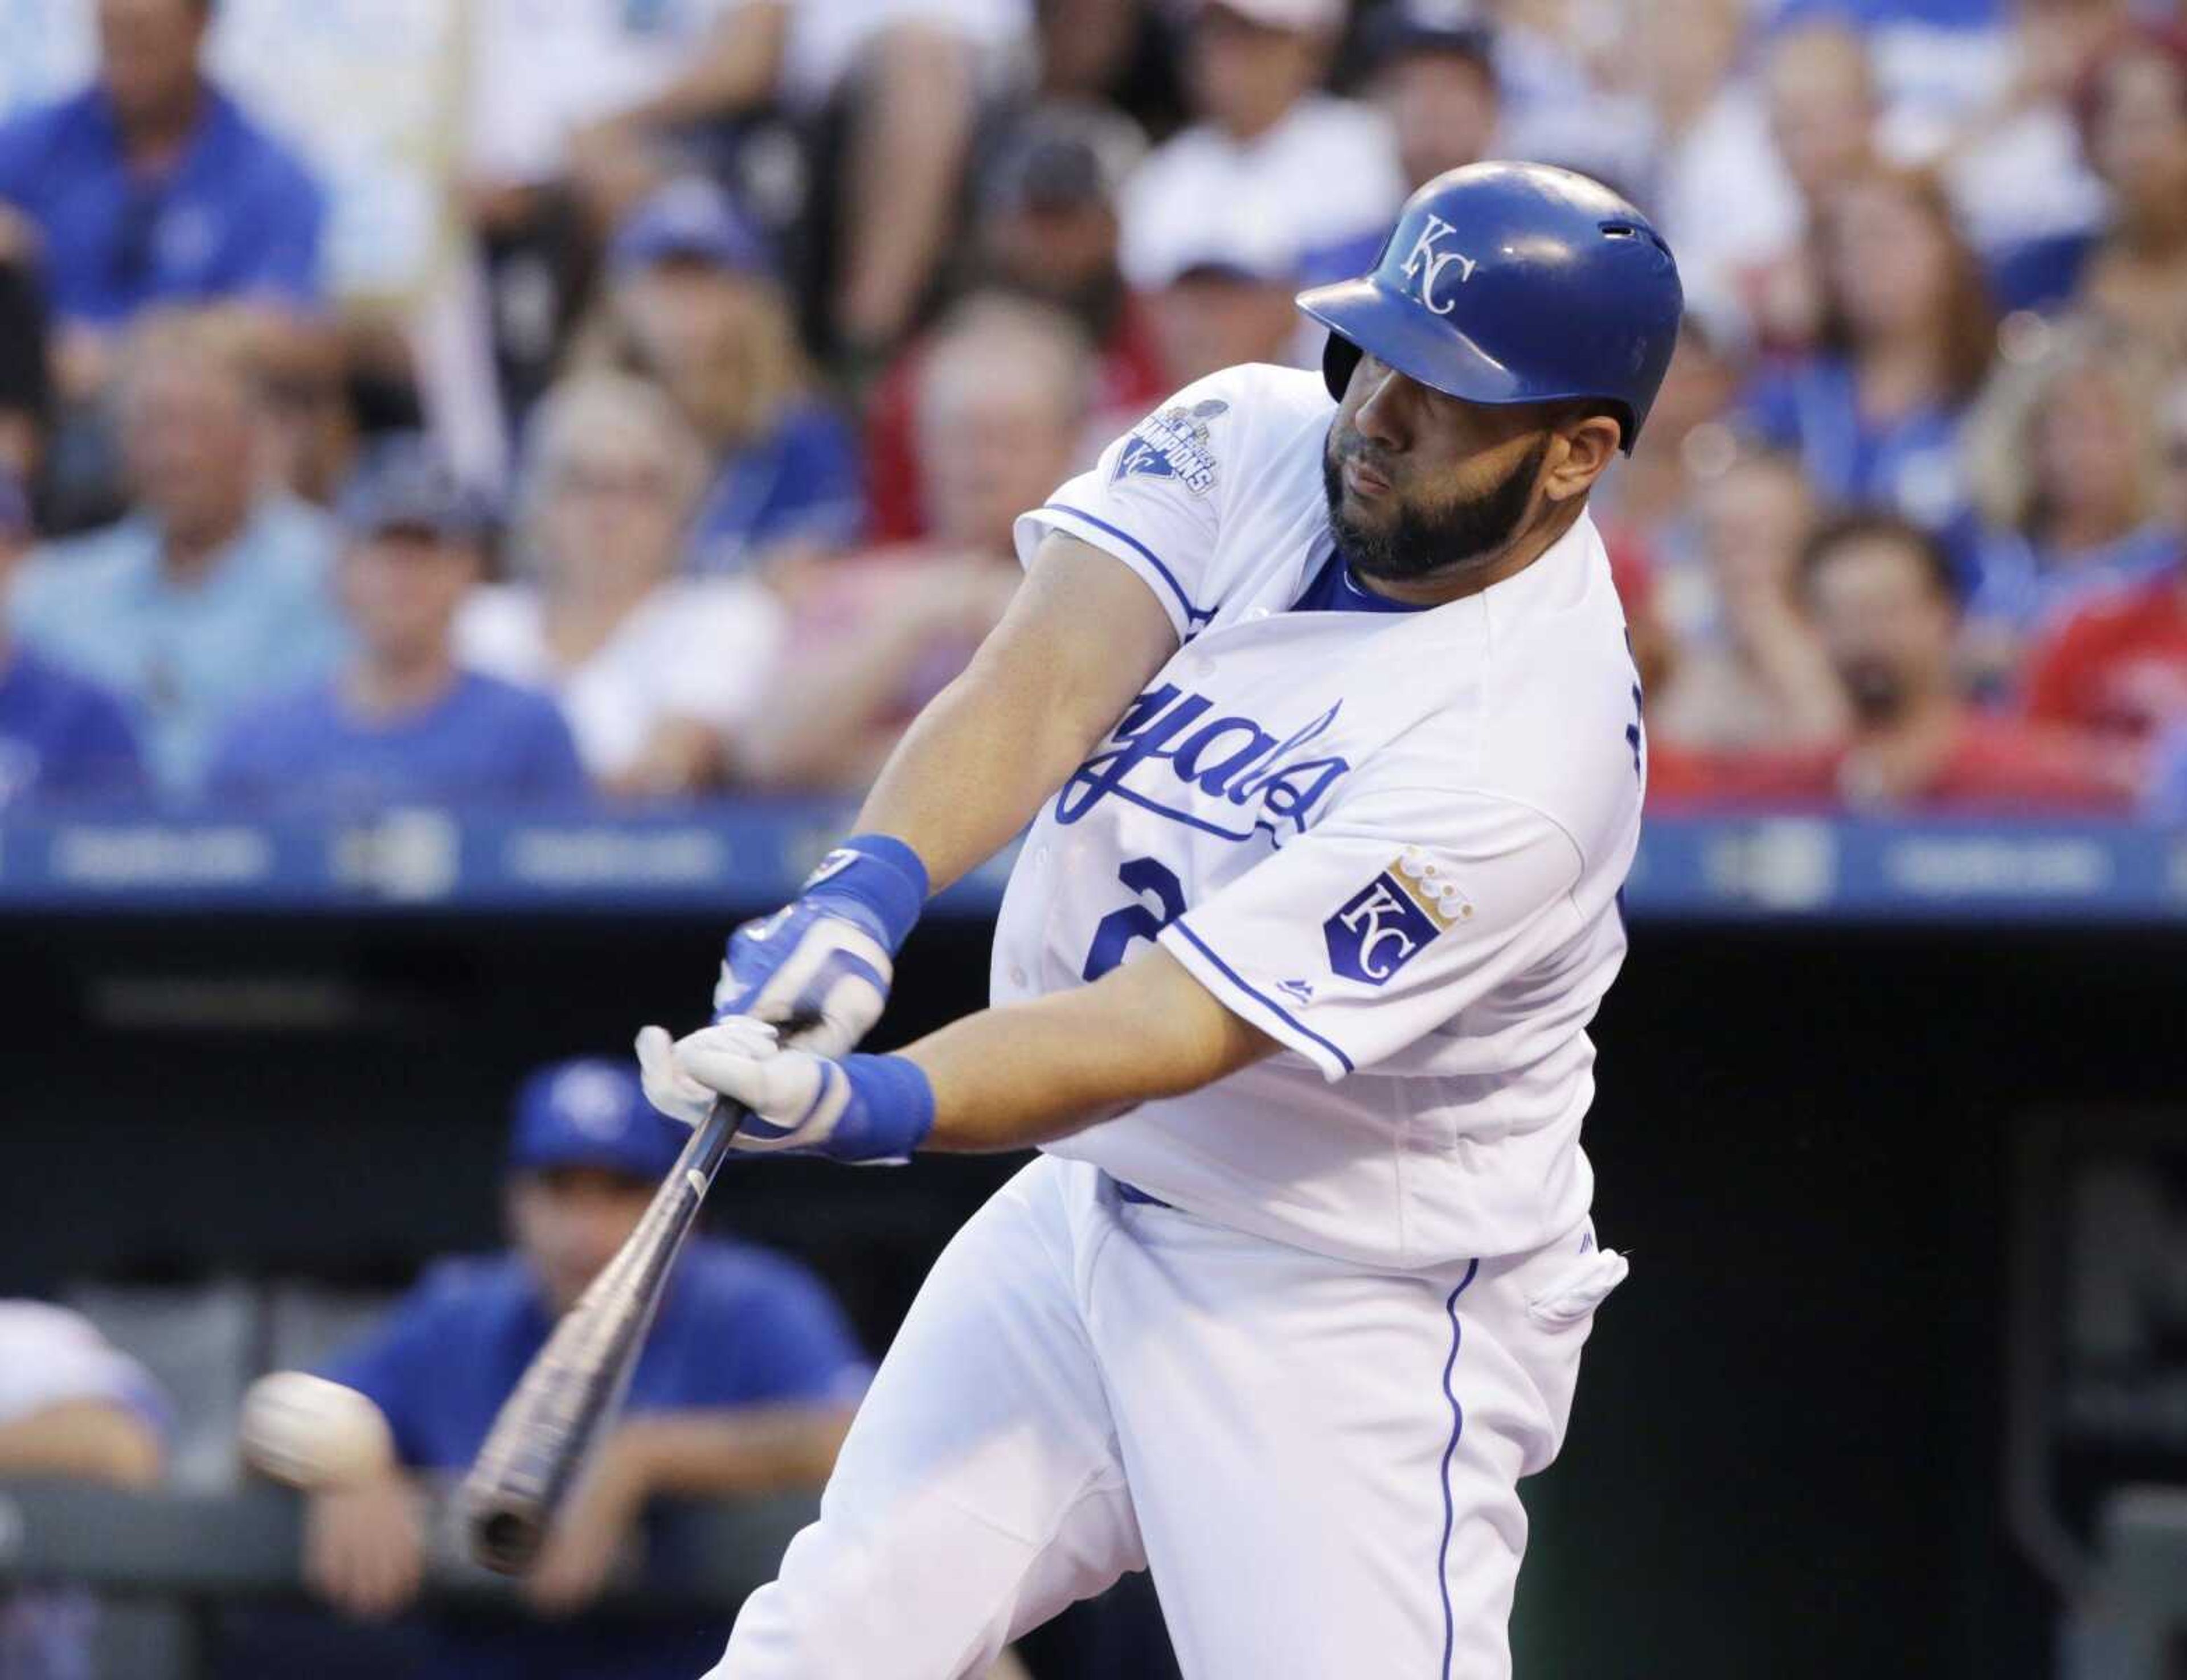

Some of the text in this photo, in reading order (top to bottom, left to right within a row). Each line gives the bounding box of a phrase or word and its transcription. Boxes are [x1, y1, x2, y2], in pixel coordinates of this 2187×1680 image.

[1400, 214, 1476, 314] KC
[1055, 683, 1350, 849] yals
[1340, 883, 1416, 978] KC
